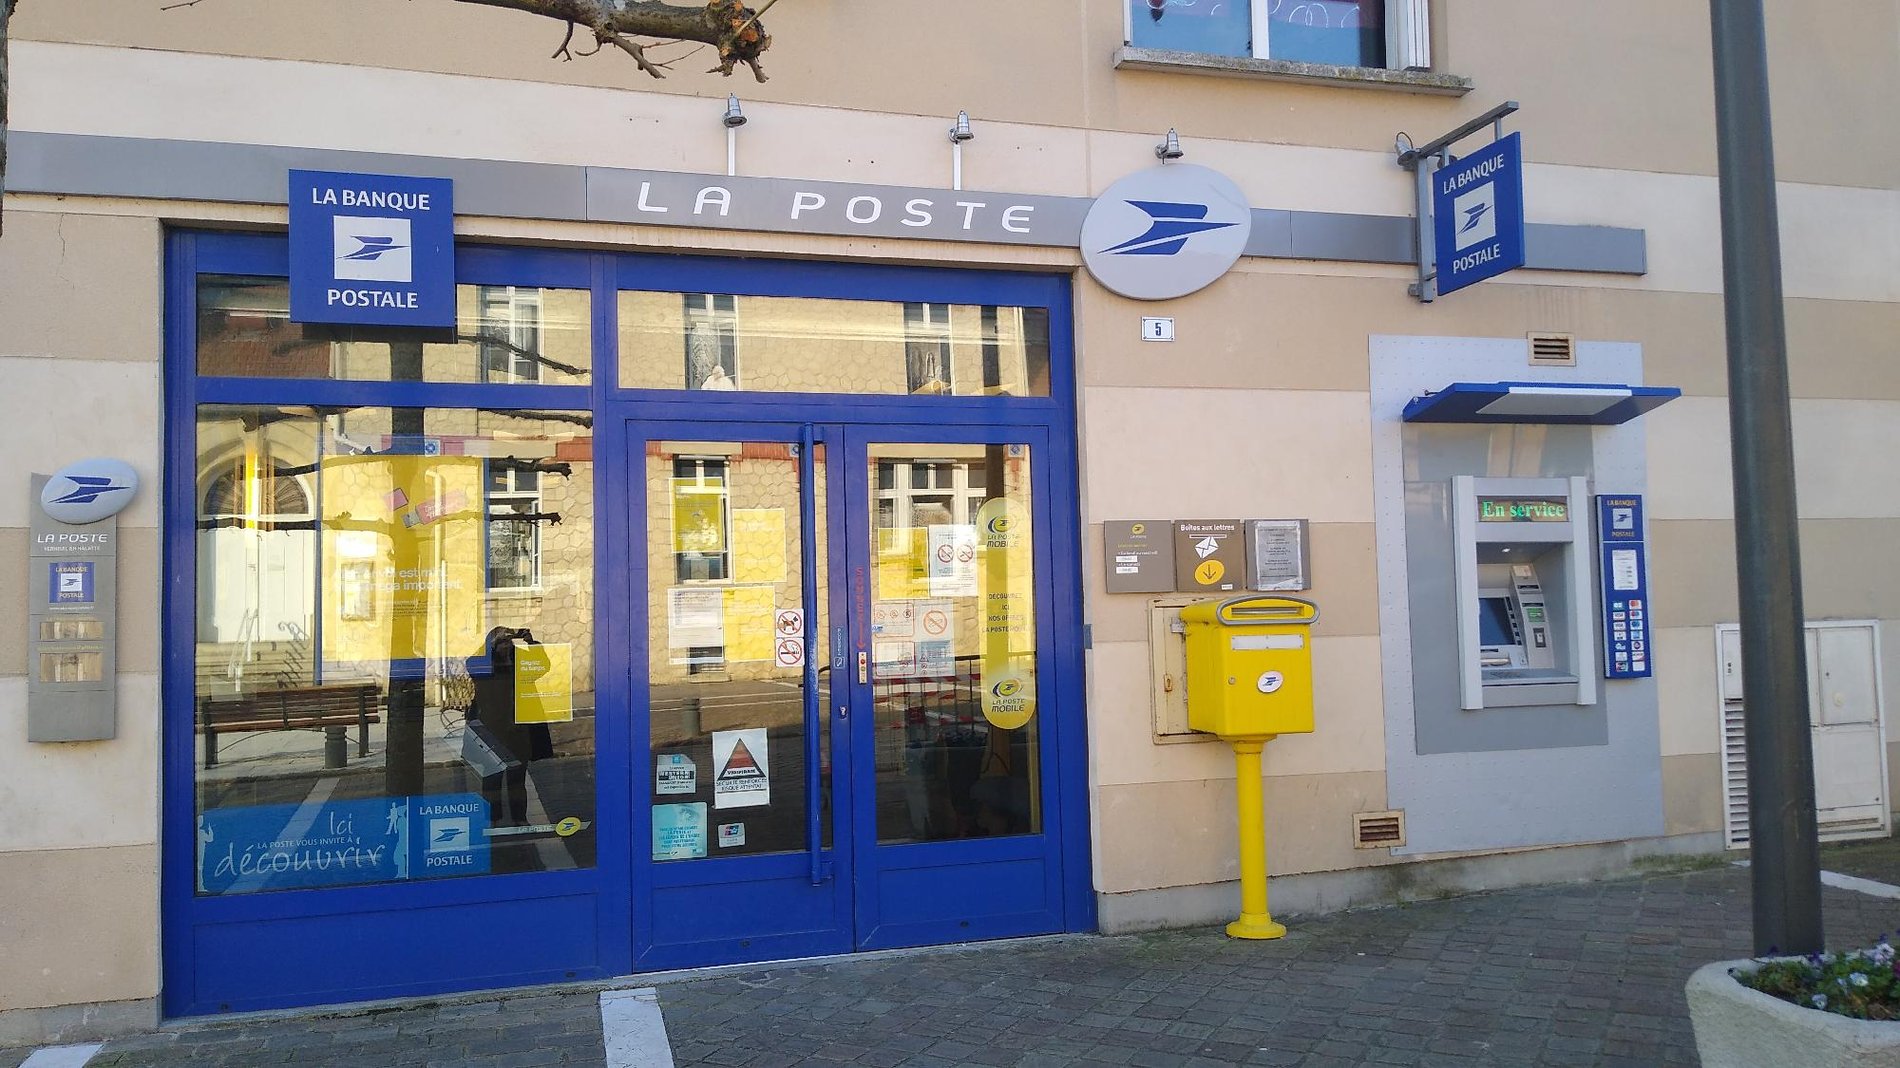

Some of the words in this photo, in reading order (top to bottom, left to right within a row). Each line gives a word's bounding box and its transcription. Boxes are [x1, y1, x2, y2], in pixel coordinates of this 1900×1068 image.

[1443, 179, 1457, 196] LA
[1458, 153, 1505, 188] BANQUE
[312, 187, 338, 206] LA
[342, 189, 431, 212] BANQUE
[636, 181, 733, 217] LA
[790, 191, 1037, 234] POSTE
[1452, 243, 1502, 275] POSTALE
[327, 289, 420, 309] POSTALE
[1154, 322, 1162, 337] 5
[1482, 501, 1505, 518] En
[1510, 501, 1565, 518] service
[1180, 523, 1201, 531] Boîtes
[37, 533, 55, 543] LA
[59, 533, 109, 543] POSTE
[986, 540, 1021, 548] MOBILE
[991, 704, 1025, 712] MOBILE
[419, 806, 433, 816] LA
[434, 803, 480, 815] BANQUE
[329, 811, 354, 836] Ici
[269, 840, 294, 849] POSTE
[296, 838, 318, 847] VOUS
[319, 836, 346, 846] INVITE
[214, 838, 387, 878] découvrir
[426, 854, 473, 867] POSTALE
